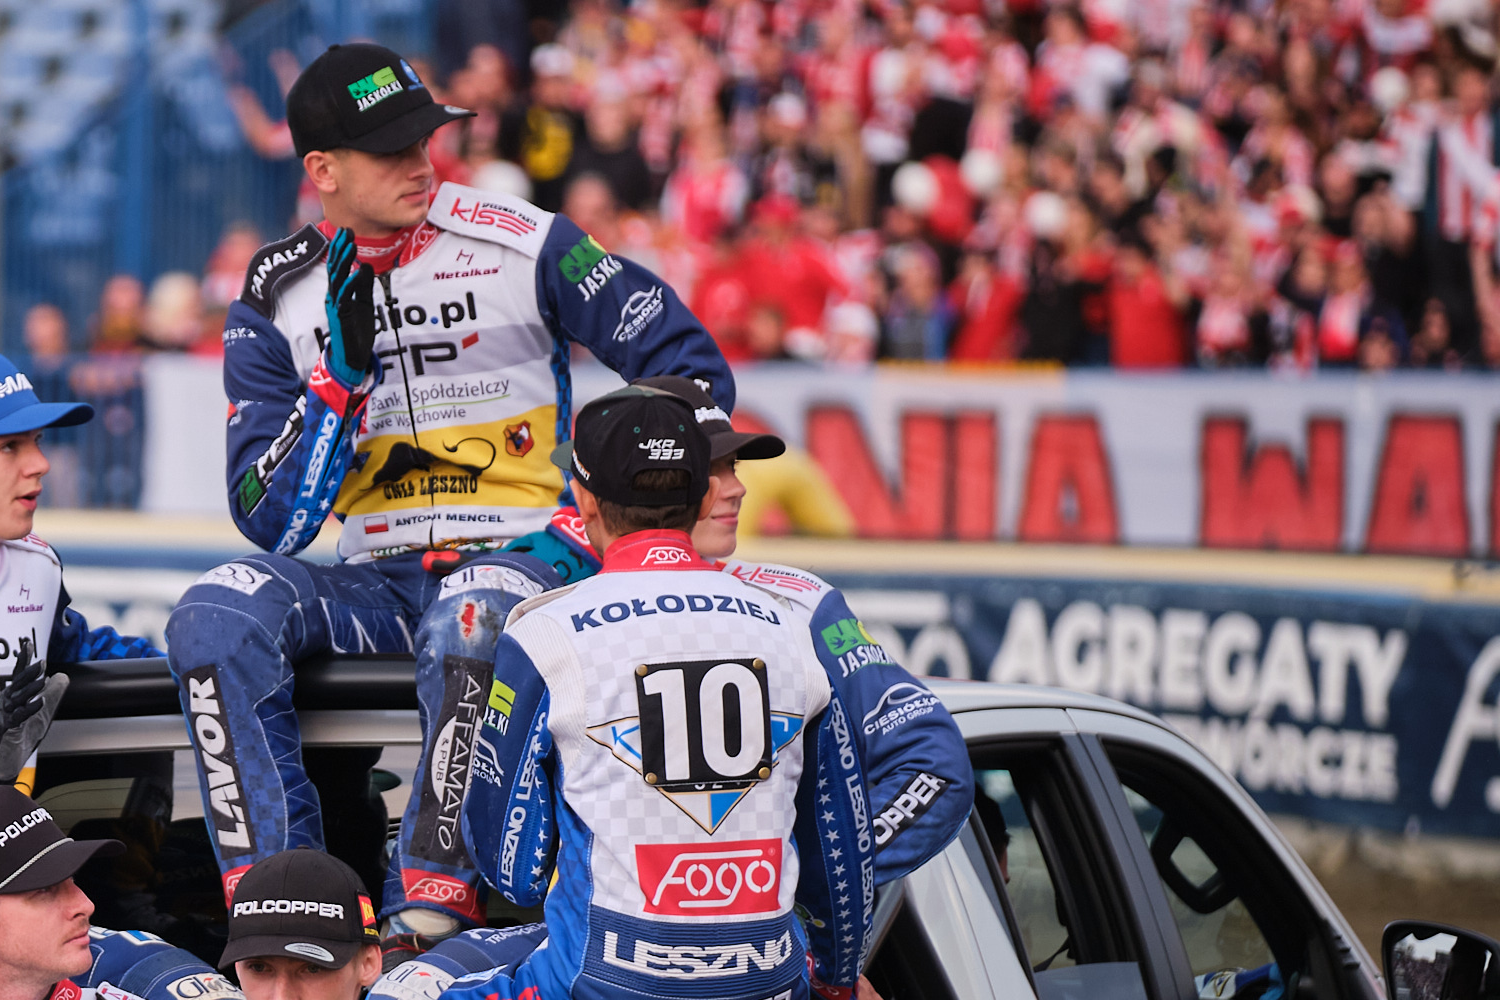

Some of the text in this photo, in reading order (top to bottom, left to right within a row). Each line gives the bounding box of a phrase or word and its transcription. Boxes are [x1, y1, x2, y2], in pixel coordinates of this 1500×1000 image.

[251, 240, 309, 299] CANAL+
[433, 267, 500, 281] Metalkas
[371, 379, 510, 412] Bank Spółdzielczy
[372, 417, 393, 431] we
[301, 412, 338, 498] LESZNO
[638, 438, 677, 450] JKR
[648, 448, 685, 460] 333
[419, 474, 479, 496] LESZNO
[1200, 414, 1500, 557] WA
[446, 513, 505, 524] MENCEL
[640, 546, 692, 566] Fogo
[570, 594, 781, 633] KOŁODZIEJ
[990, 597, 1406, 729] AGREGATY
[642, 662, 766, 781] 10
[882, 715, 908, 736] AUTO
[189, 676, 252, 848] LAVOR
[436, 750, 448, 782] PUB
[437, 674, 482, 851] AFFAMATO
[845, 773, 872, 854] LESZNO
[500, 805, 527, 887] LESZNO
[405, 877, 467, 902] Fogo
[652, 849, 776, 908] Fogo
[233, 899, 345, 920] POLCOPPER
[603, 930, 793, 980] LESZNO
